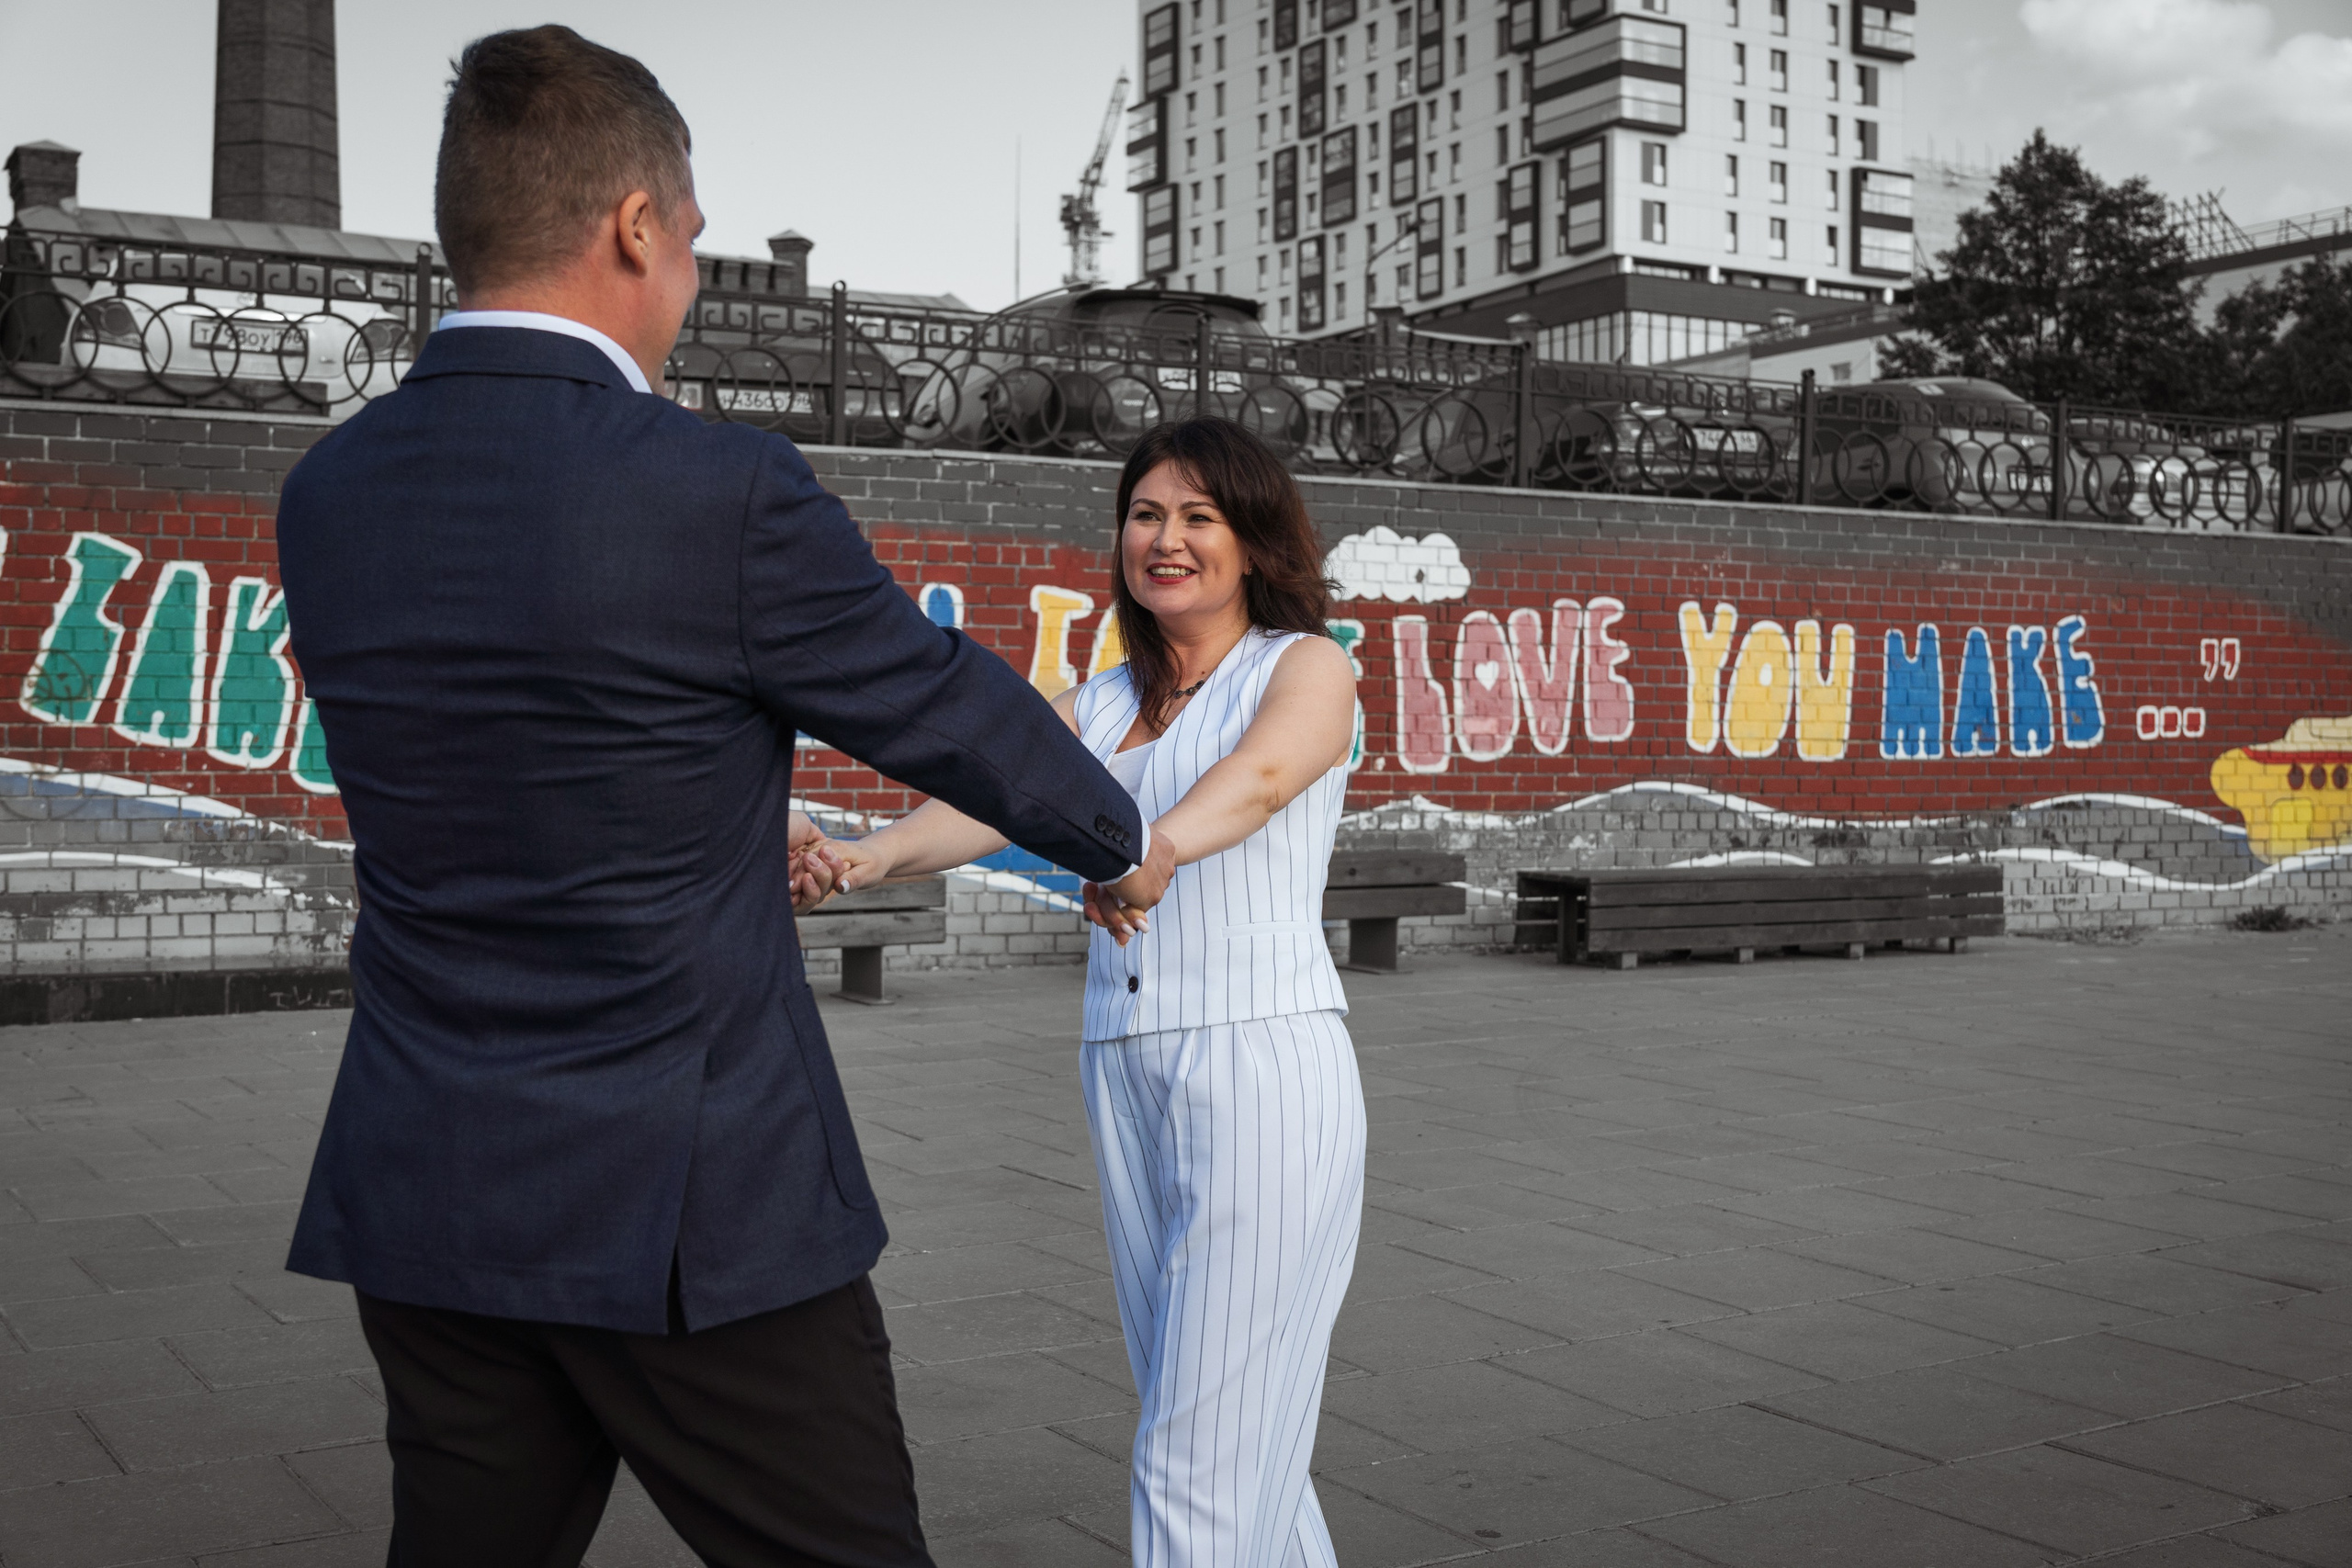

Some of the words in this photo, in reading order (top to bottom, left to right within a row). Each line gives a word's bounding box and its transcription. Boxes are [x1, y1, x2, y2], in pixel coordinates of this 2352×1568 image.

[19, 531, 341, 794] TAK
[1393, 596, 1634, 773] LOVE
[1679, 599, 1855, 763] YOU
[1879, 615, 2106, 760] MAKE
